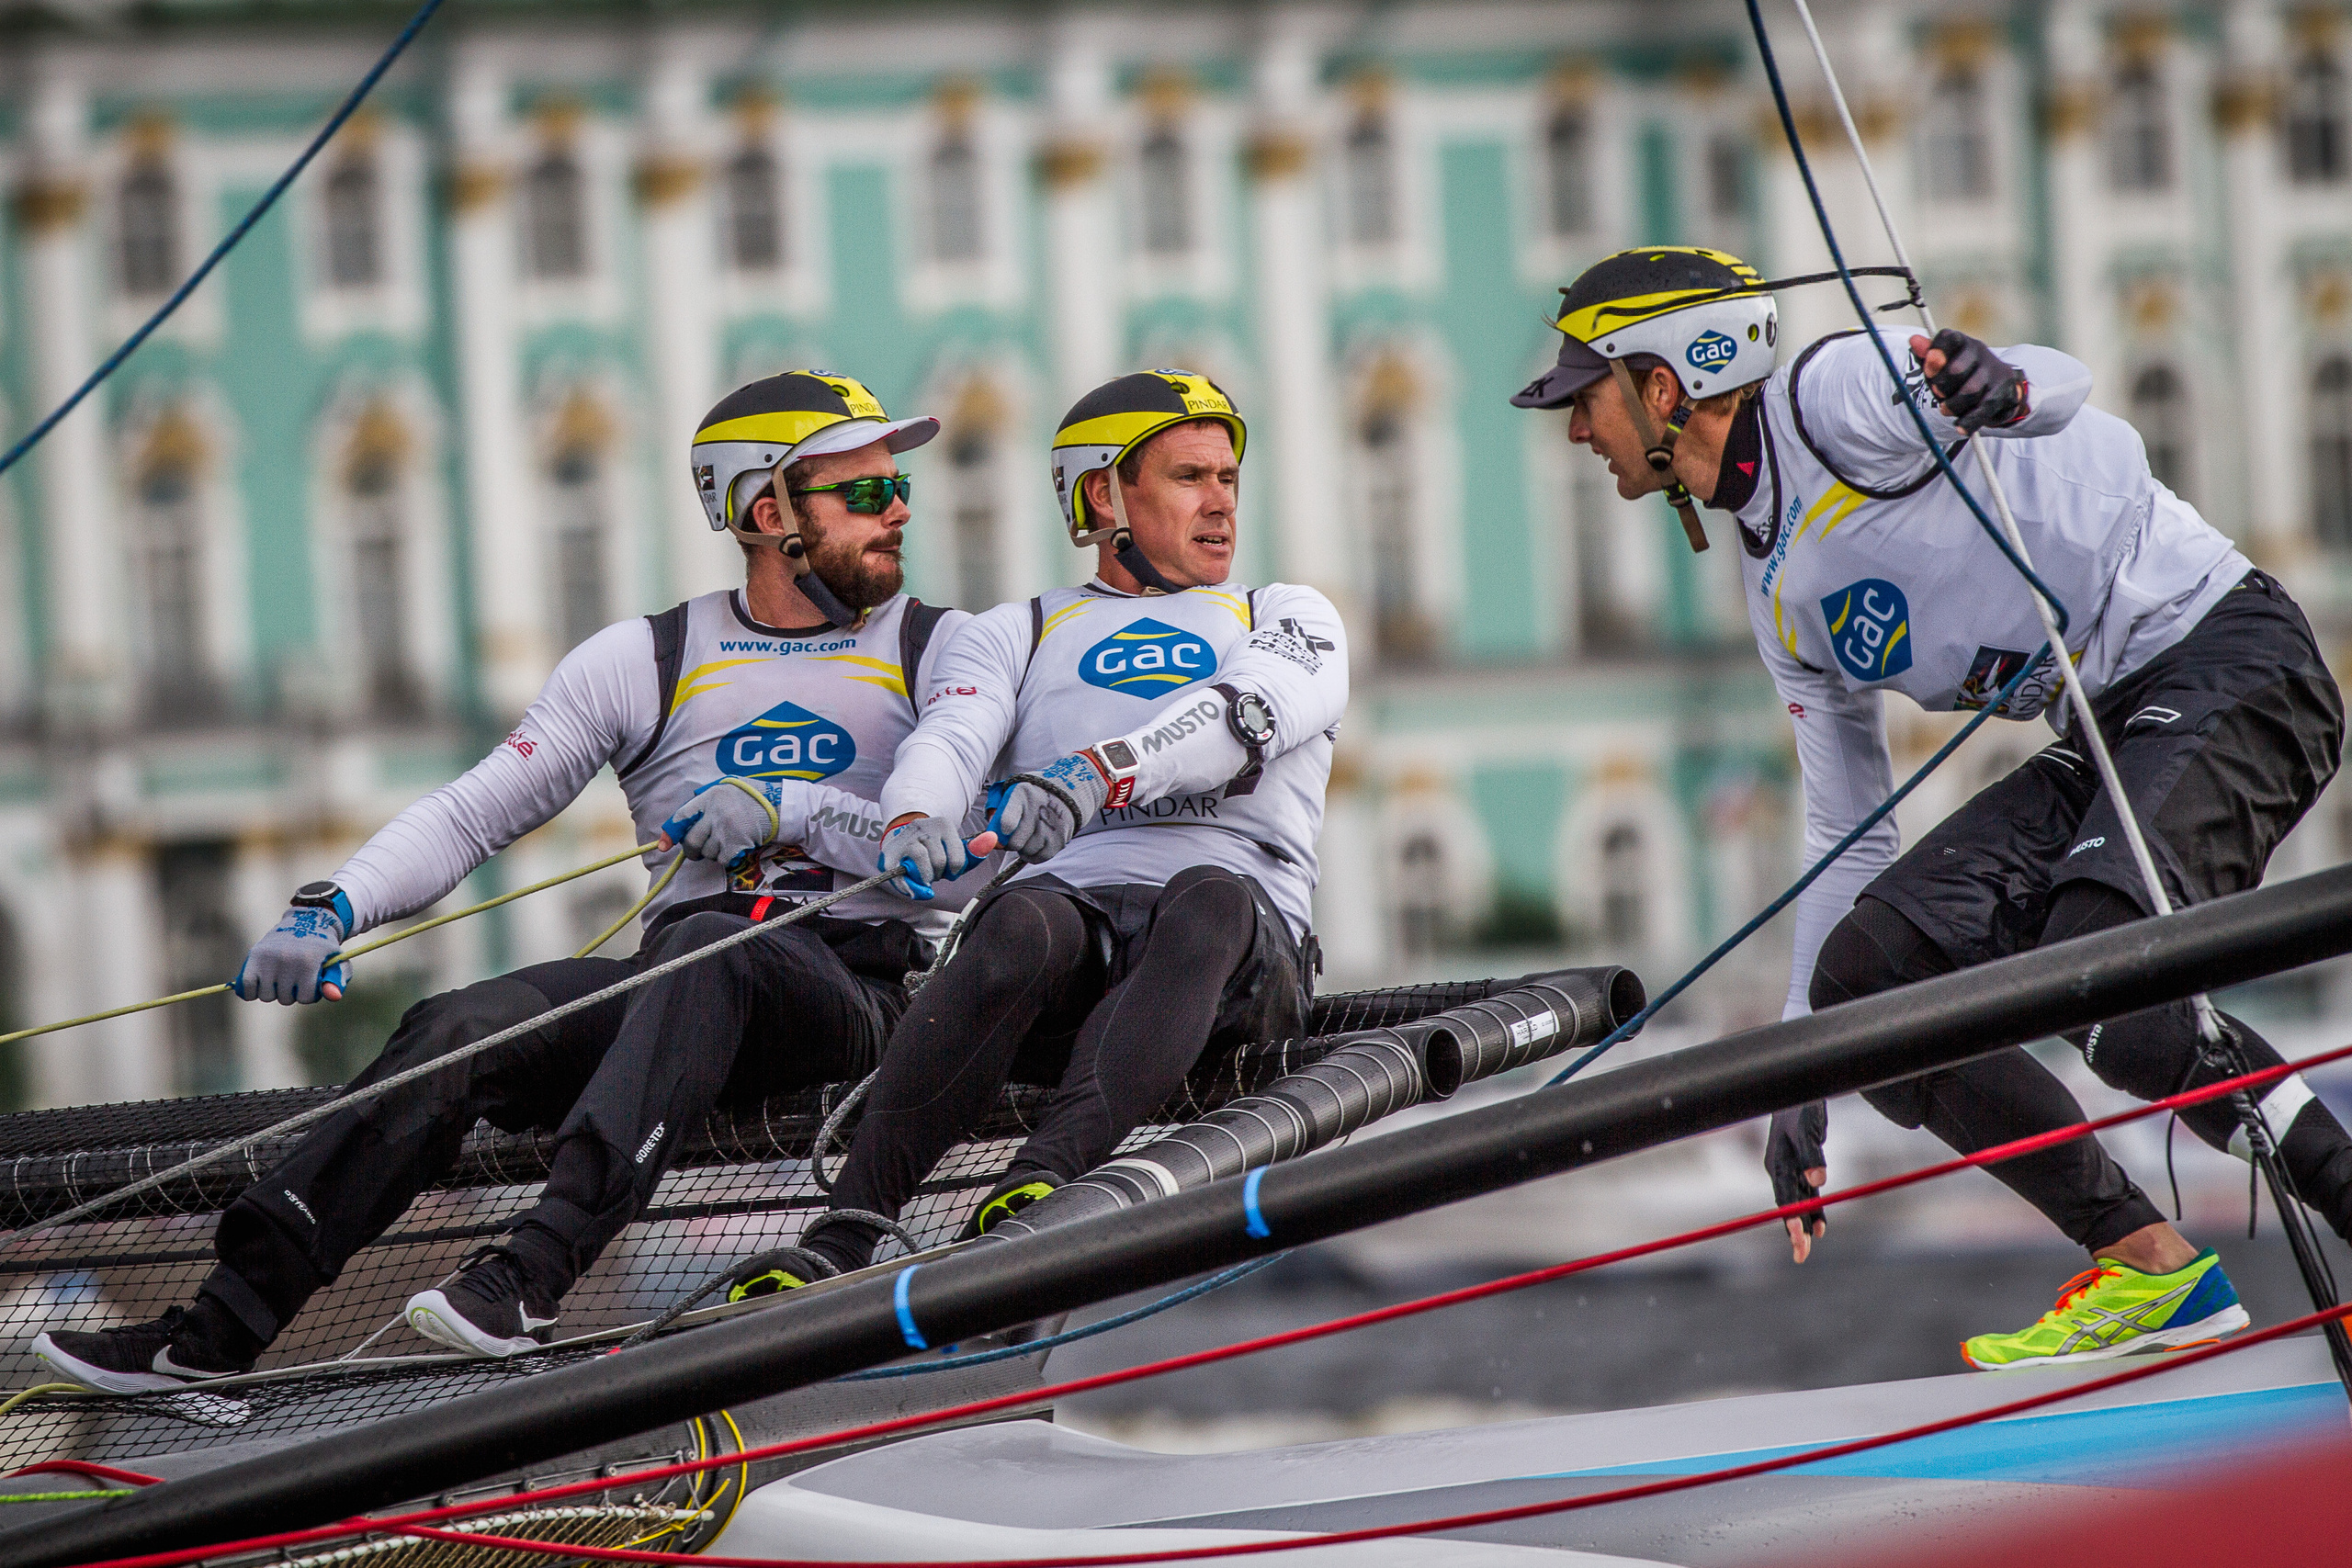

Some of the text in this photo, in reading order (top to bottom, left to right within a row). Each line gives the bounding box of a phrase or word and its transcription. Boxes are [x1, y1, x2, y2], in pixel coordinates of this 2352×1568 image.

[1760, 495, 1803, 598] www.gac.com
[719, 638, 856, 656] www.gac.com
[1141, 700, 1220, 756] MUSTO
[809, 806, 884, 842] MUS
